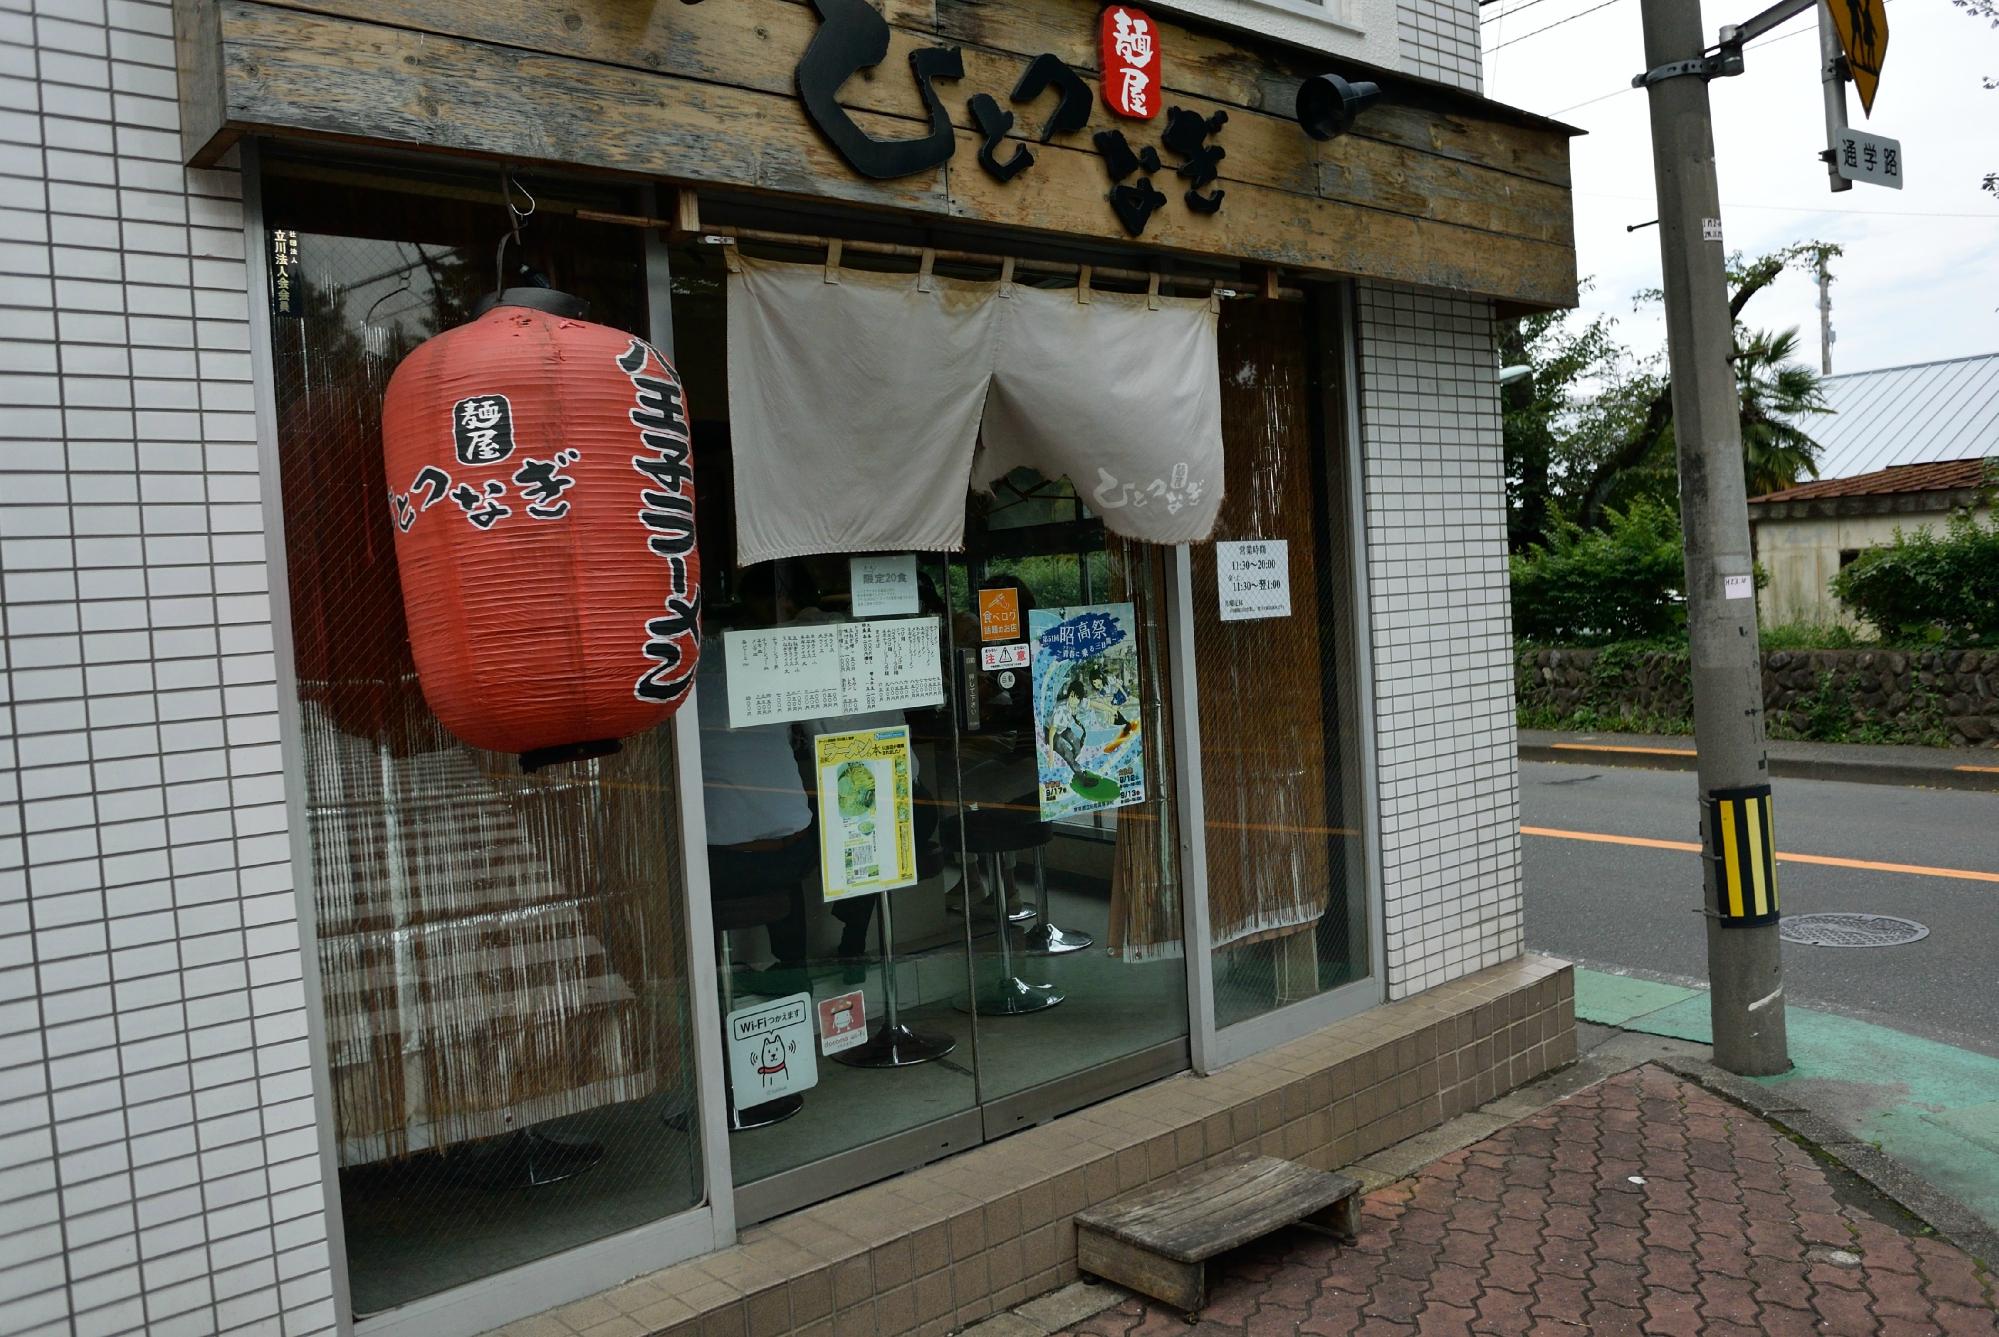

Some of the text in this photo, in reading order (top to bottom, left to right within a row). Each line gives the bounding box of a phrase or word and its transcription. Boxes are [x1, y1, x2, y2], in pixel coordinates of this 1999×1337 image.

[1112, 8, 1154, 116] 麺屋
[1842, 138, 1897, 176] 通学路
[459, 399, 504, 460] 麺屋
[616, 338, 702, 703] 八王子ラーメン
[1239, 545, 1267, 555] 営業時間
[863, 572, 908, 584] 限定20食
[982, 608, 1016, 623] 食べログ
[1059, 619, 1108, 646] 昭高祭
[740, 1009, 800, 1034] Wi-Fi つかえます
